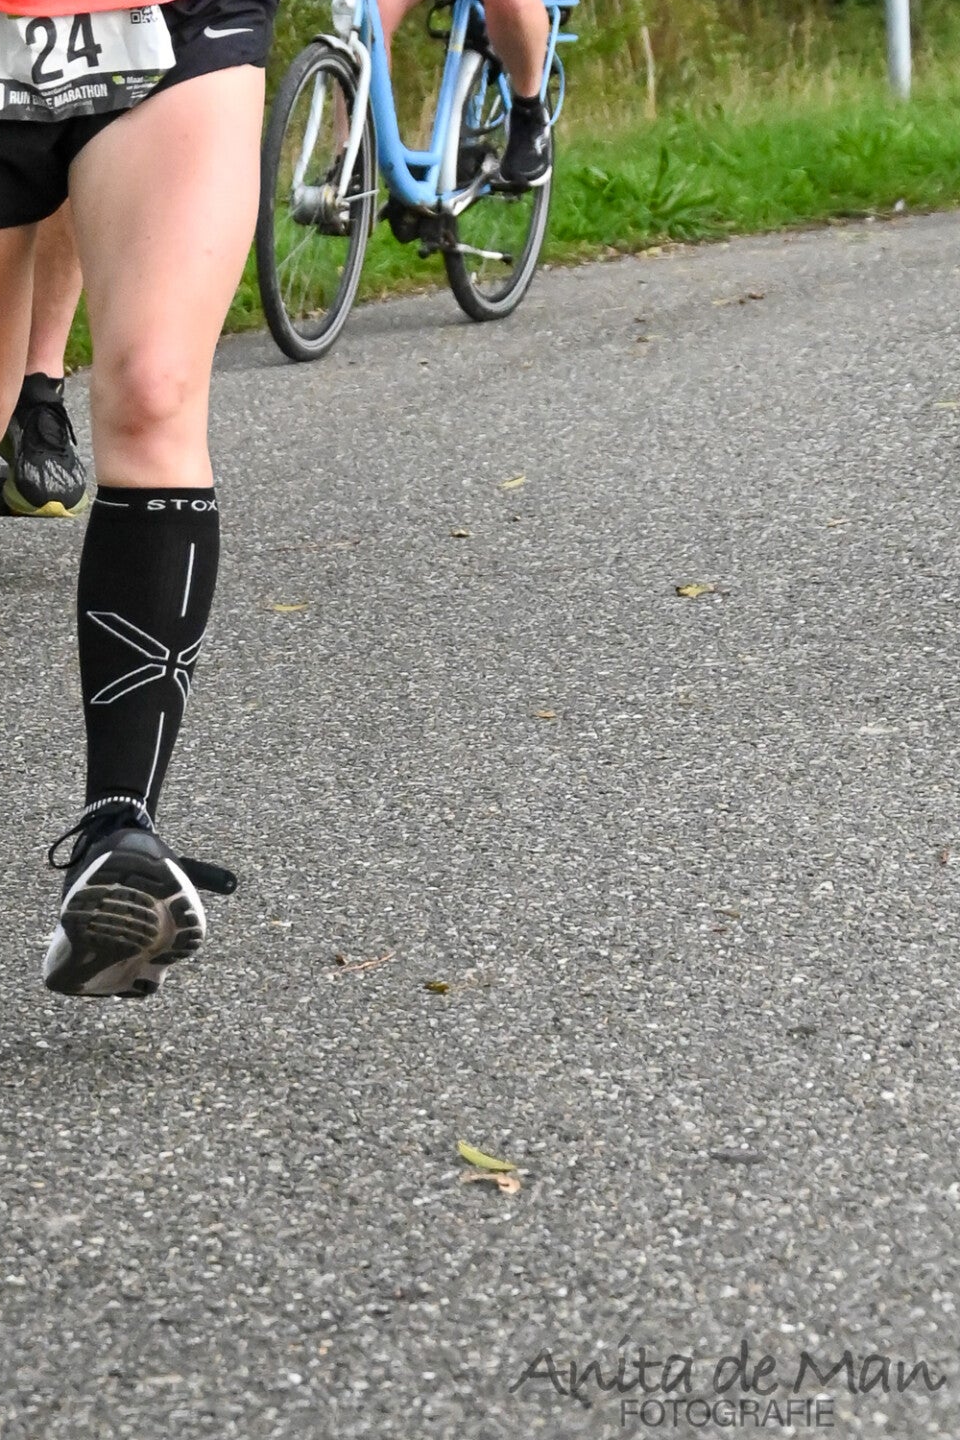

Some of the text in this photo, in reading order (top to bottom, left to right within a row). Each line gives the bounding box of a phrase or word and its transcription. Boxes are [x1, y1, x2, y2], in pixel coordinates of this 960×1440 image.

[25, 12, 103, 85] 24
[9, 90, 31, 104] RUN
[31, 93, 54, 110] BE
[54, 83, 108, 108] MARATHON
[146, 498, 218, 512] STOX
